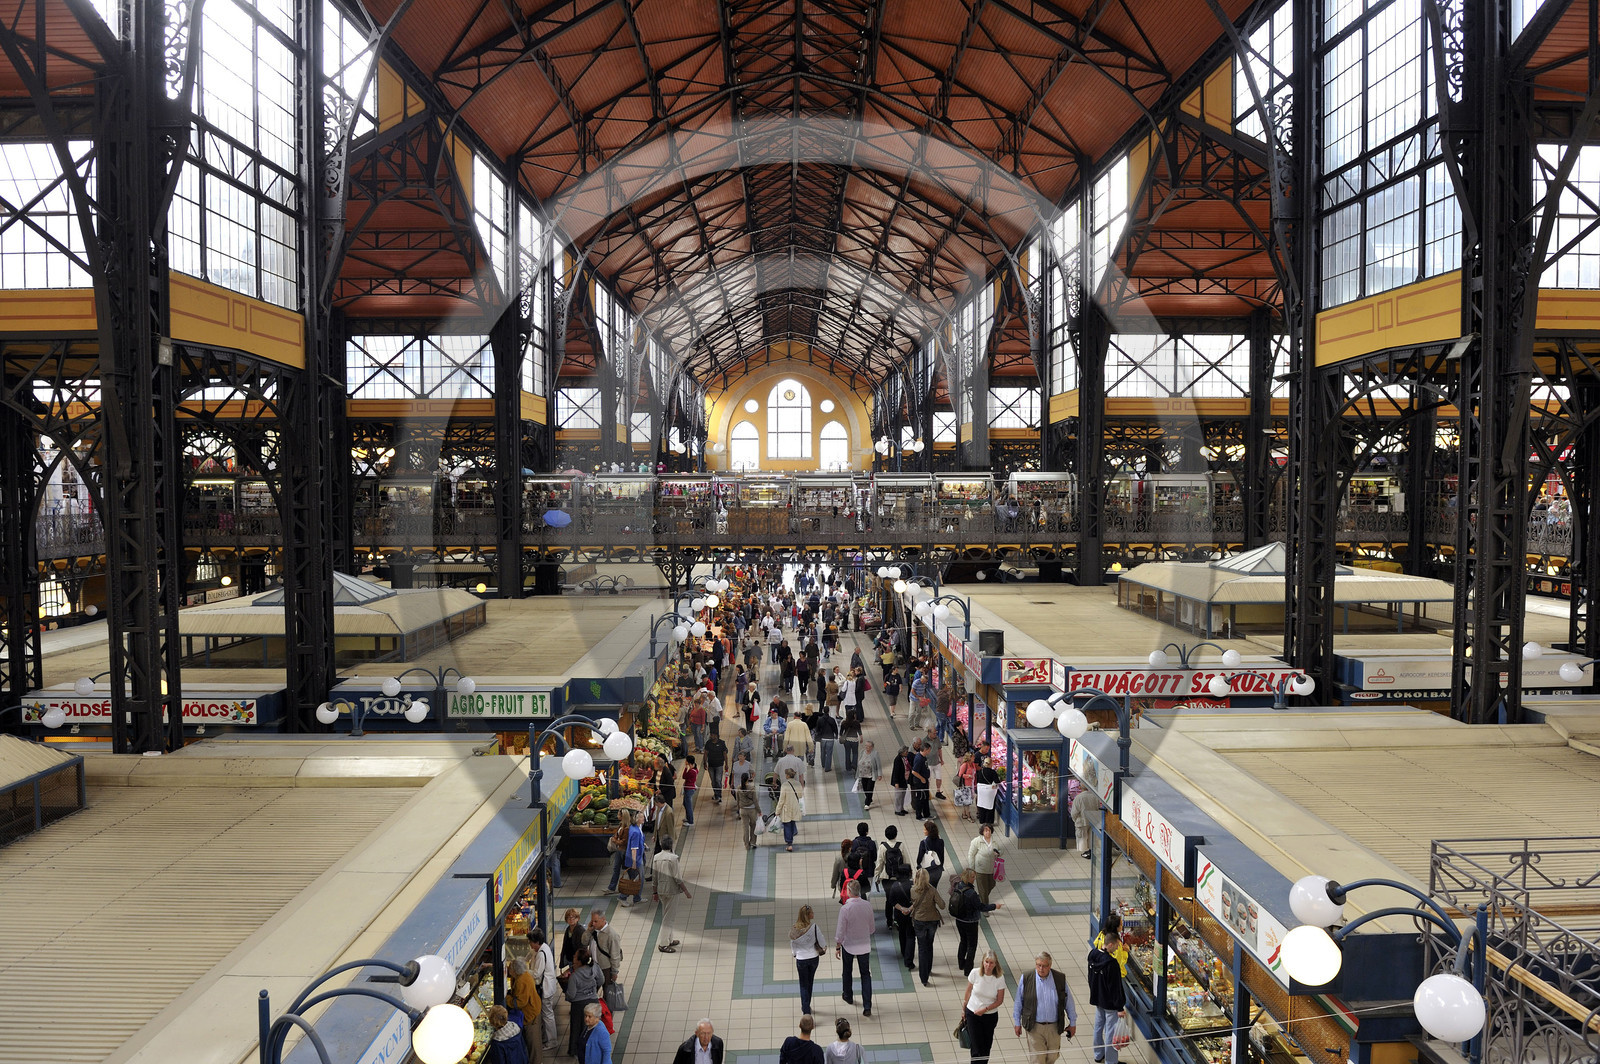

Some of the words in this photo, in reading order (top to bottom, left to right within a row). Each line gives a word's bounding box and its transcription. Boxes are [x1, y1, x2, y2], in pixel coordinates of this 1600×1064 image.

[1070, 671, 1184, 694] FELVÁGOTT
[1190, 669, 1303, 694] SZKÜZLET
[50, 700, 112, 717] ÖLDSÉ
[451, 694, 524, 715] AGRO-FRUIT
[531, 694, 548, 715] BT.
[1145, 812, 1155, 844] &
[445, 911, 481, 966] EJTERMÉK
